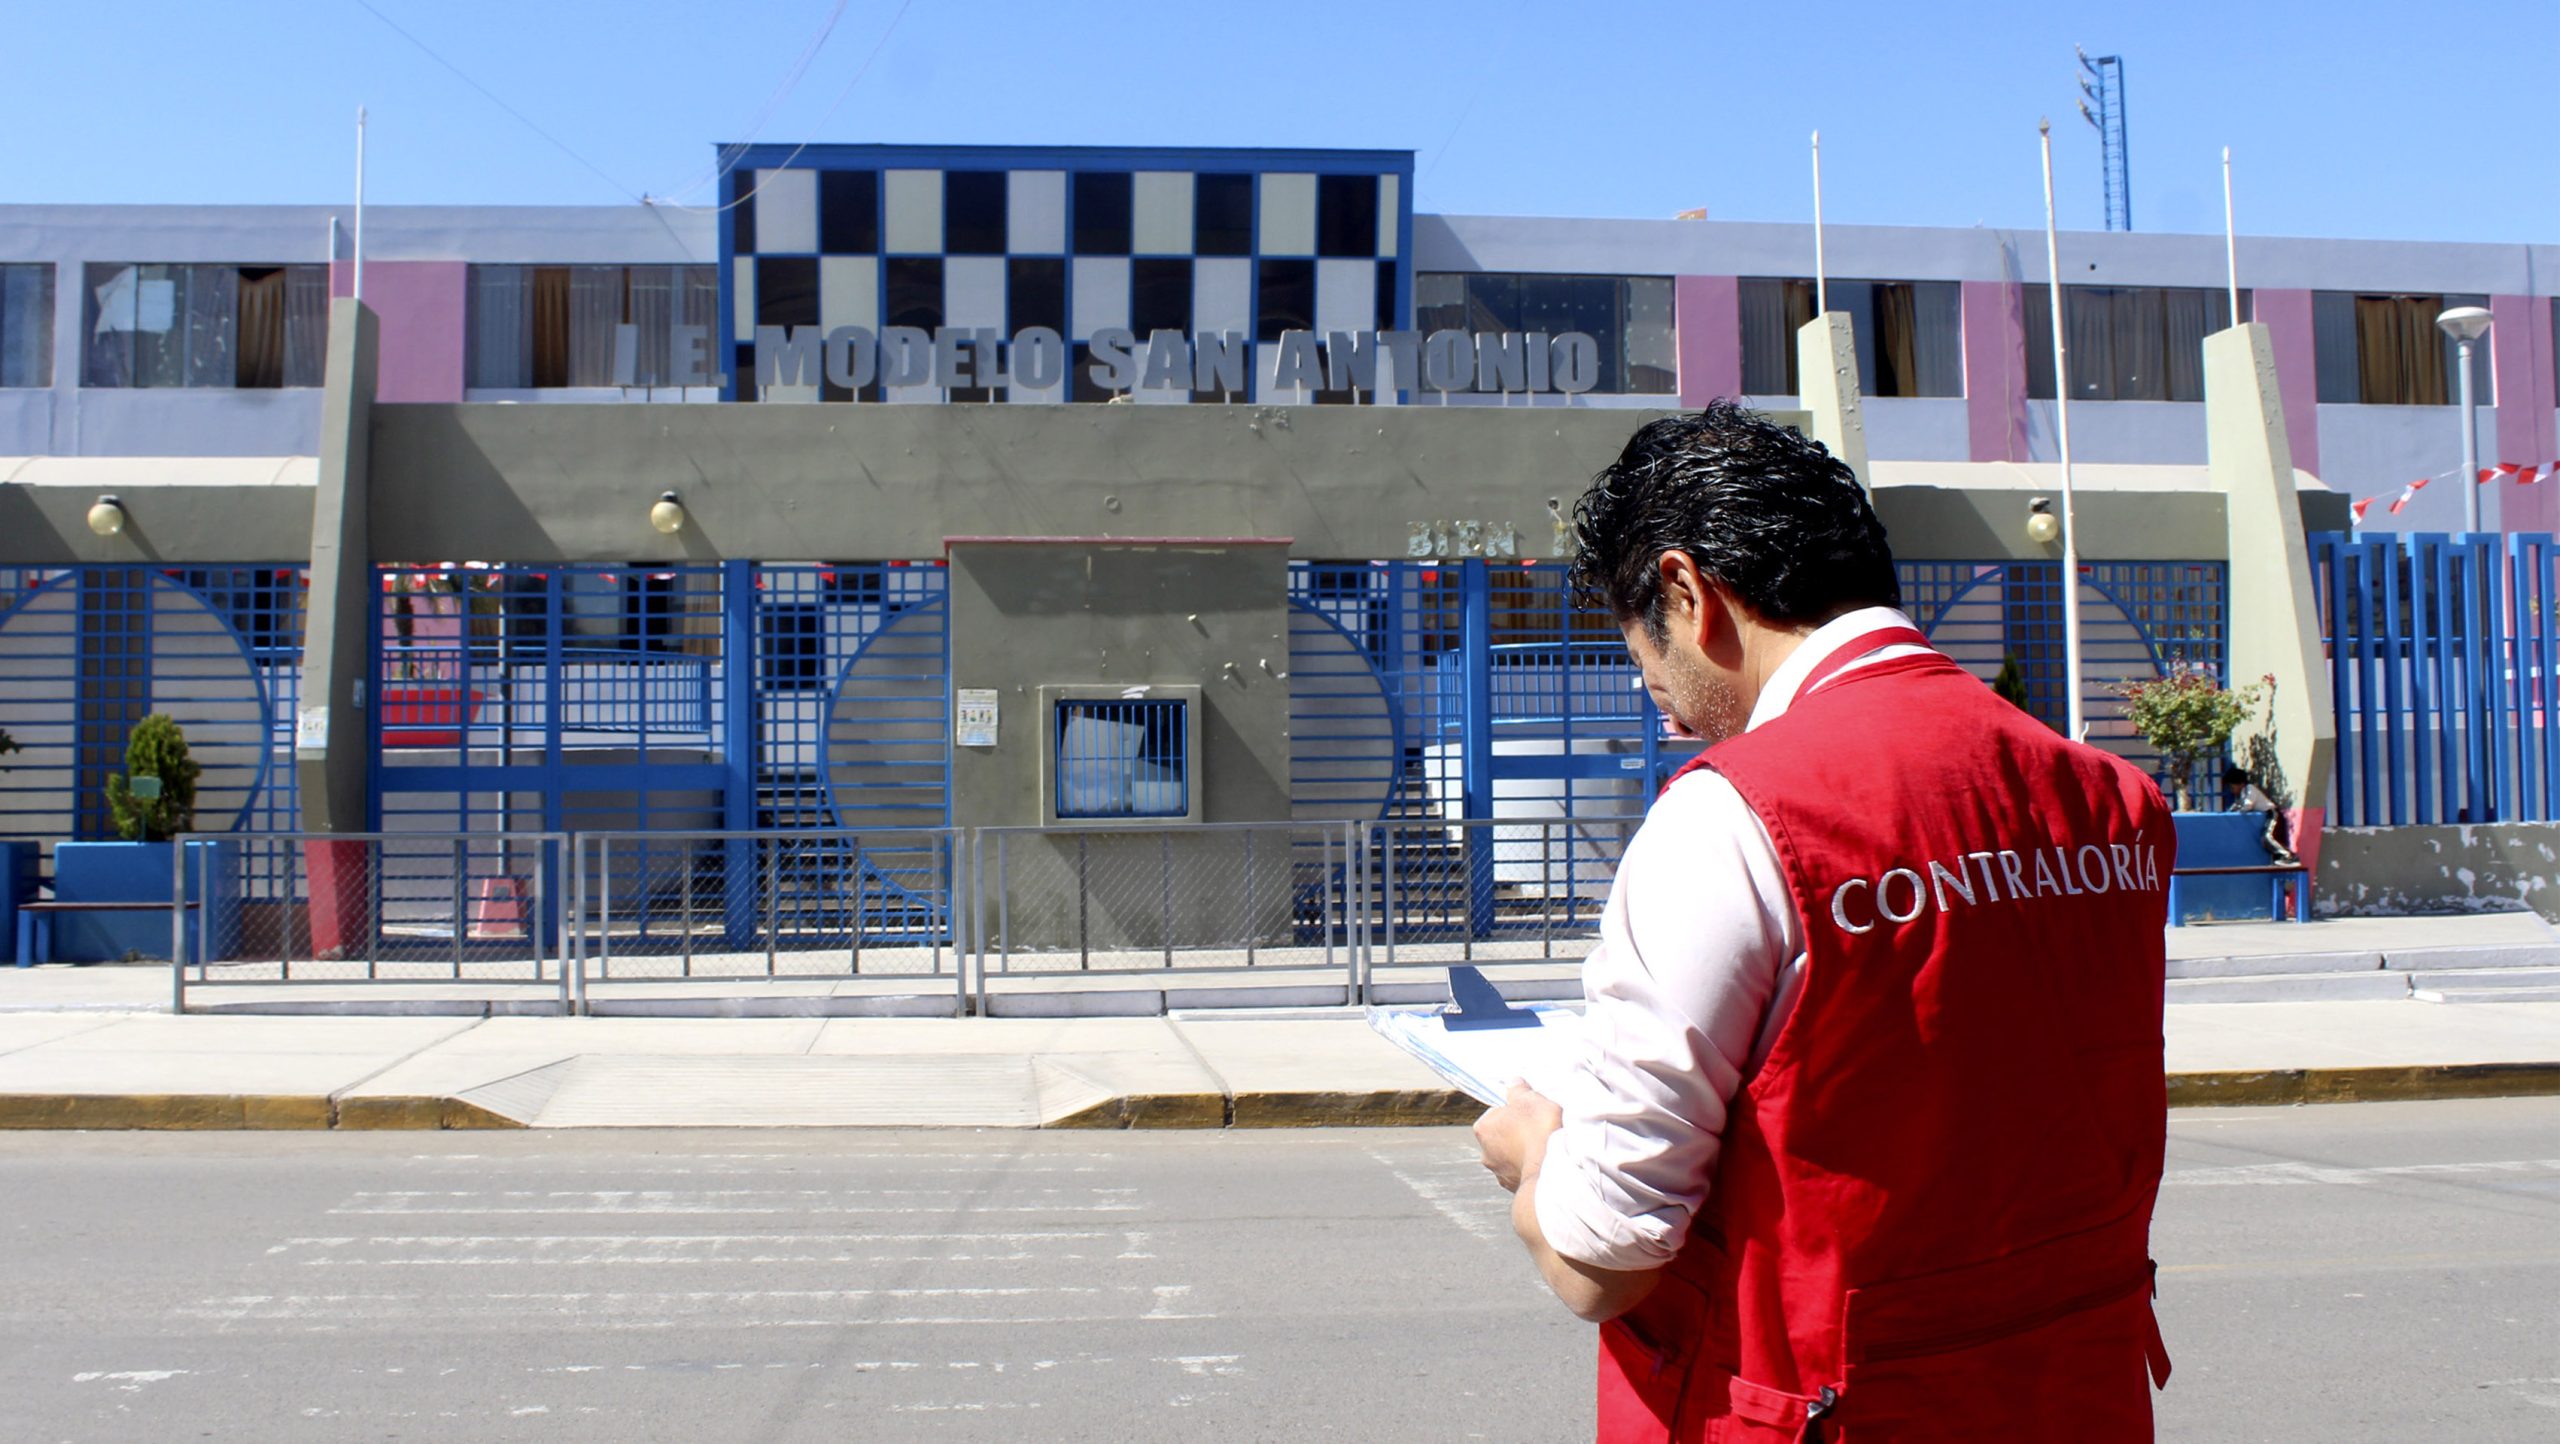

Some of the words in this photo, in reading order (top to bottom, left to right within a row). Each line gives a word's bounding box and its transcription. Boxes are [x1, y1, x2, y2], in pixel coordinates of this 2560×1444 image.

[755, 325, 1064, 388] MODELO
[1089, 327, 1243, 392] SAN
[1274, 328, 1598, 393] ANTONIO
[1831, 829, 2160, 934] CONTRALORÍA
